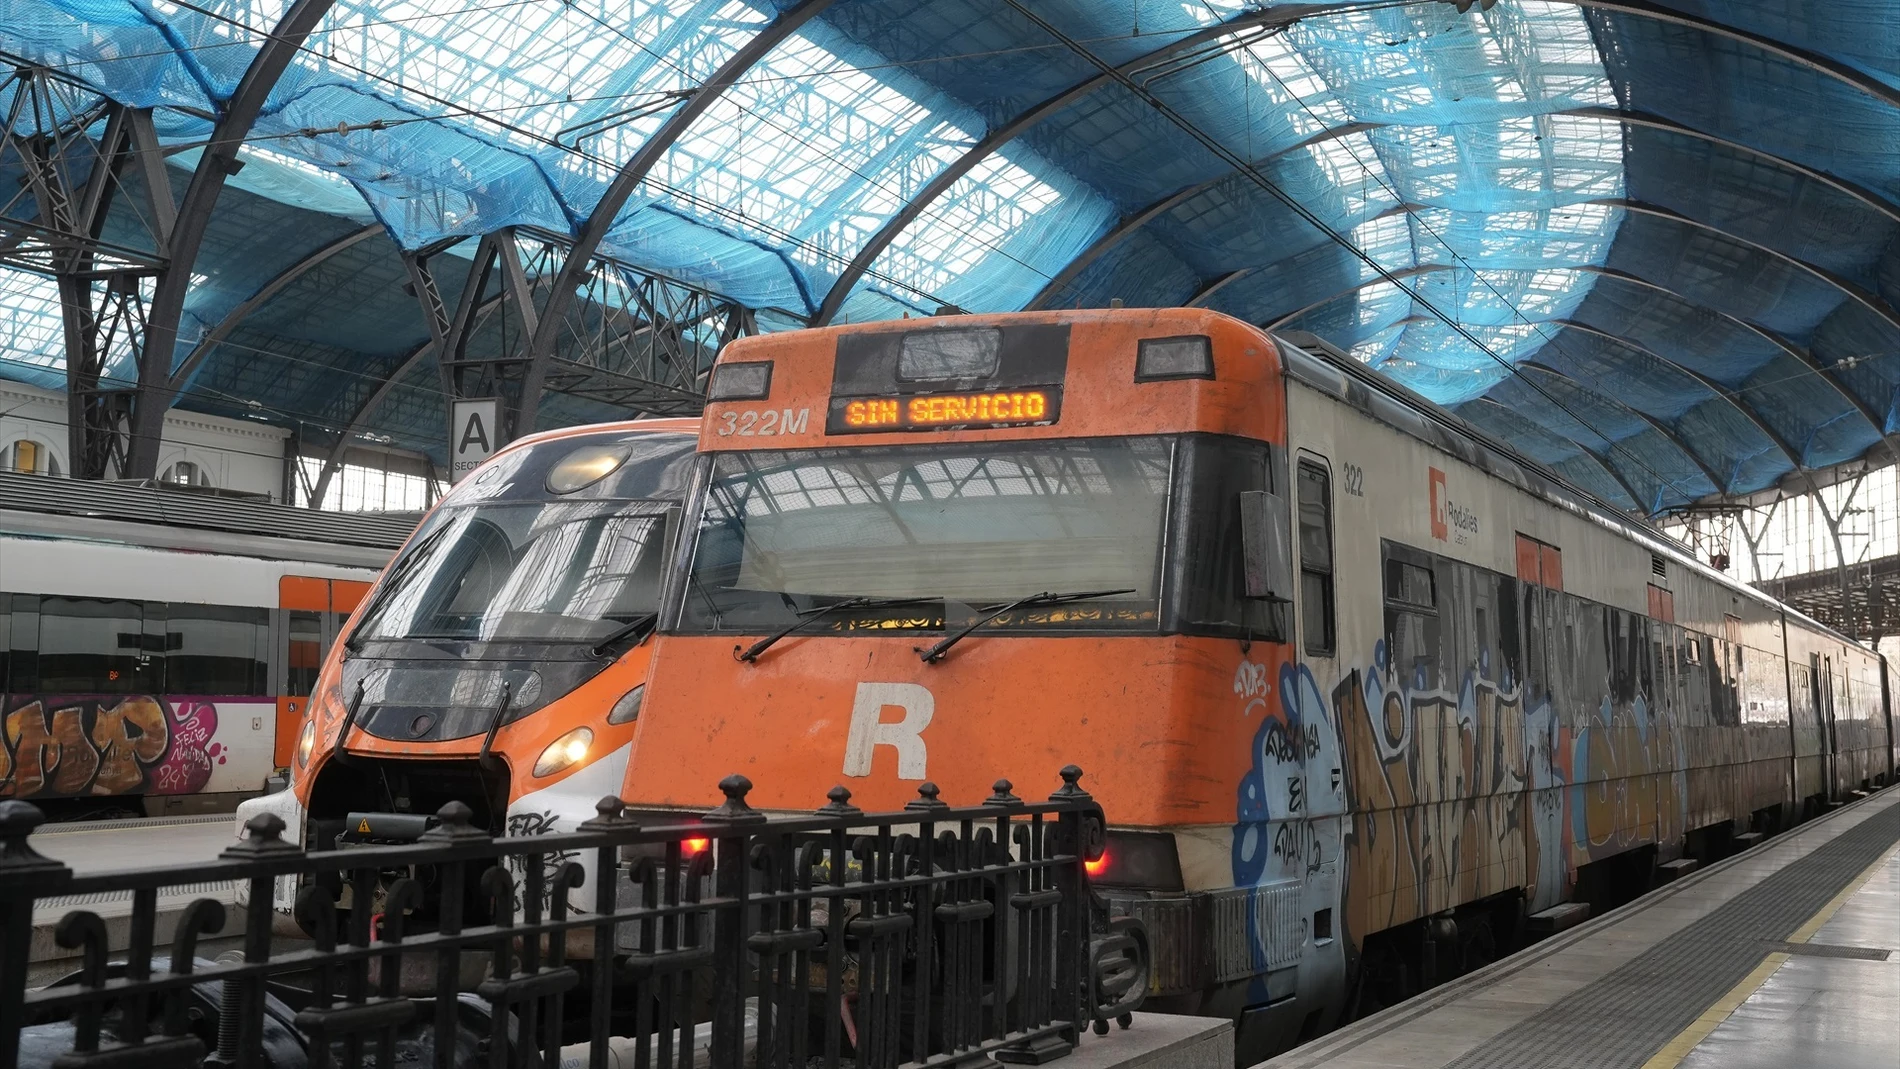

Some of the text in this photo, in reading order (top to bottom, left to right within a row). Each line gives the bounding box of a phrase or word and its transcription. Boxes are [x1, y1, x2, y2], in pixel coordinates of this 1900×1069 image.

[717, 408, 810, 437] 322M
[848, 393, 1045, 425] SIN SERVICIO
[458, 412, 490, 455] A
[1343, 462, 1364, 498] 322
[842, 681, 935, 780] R
